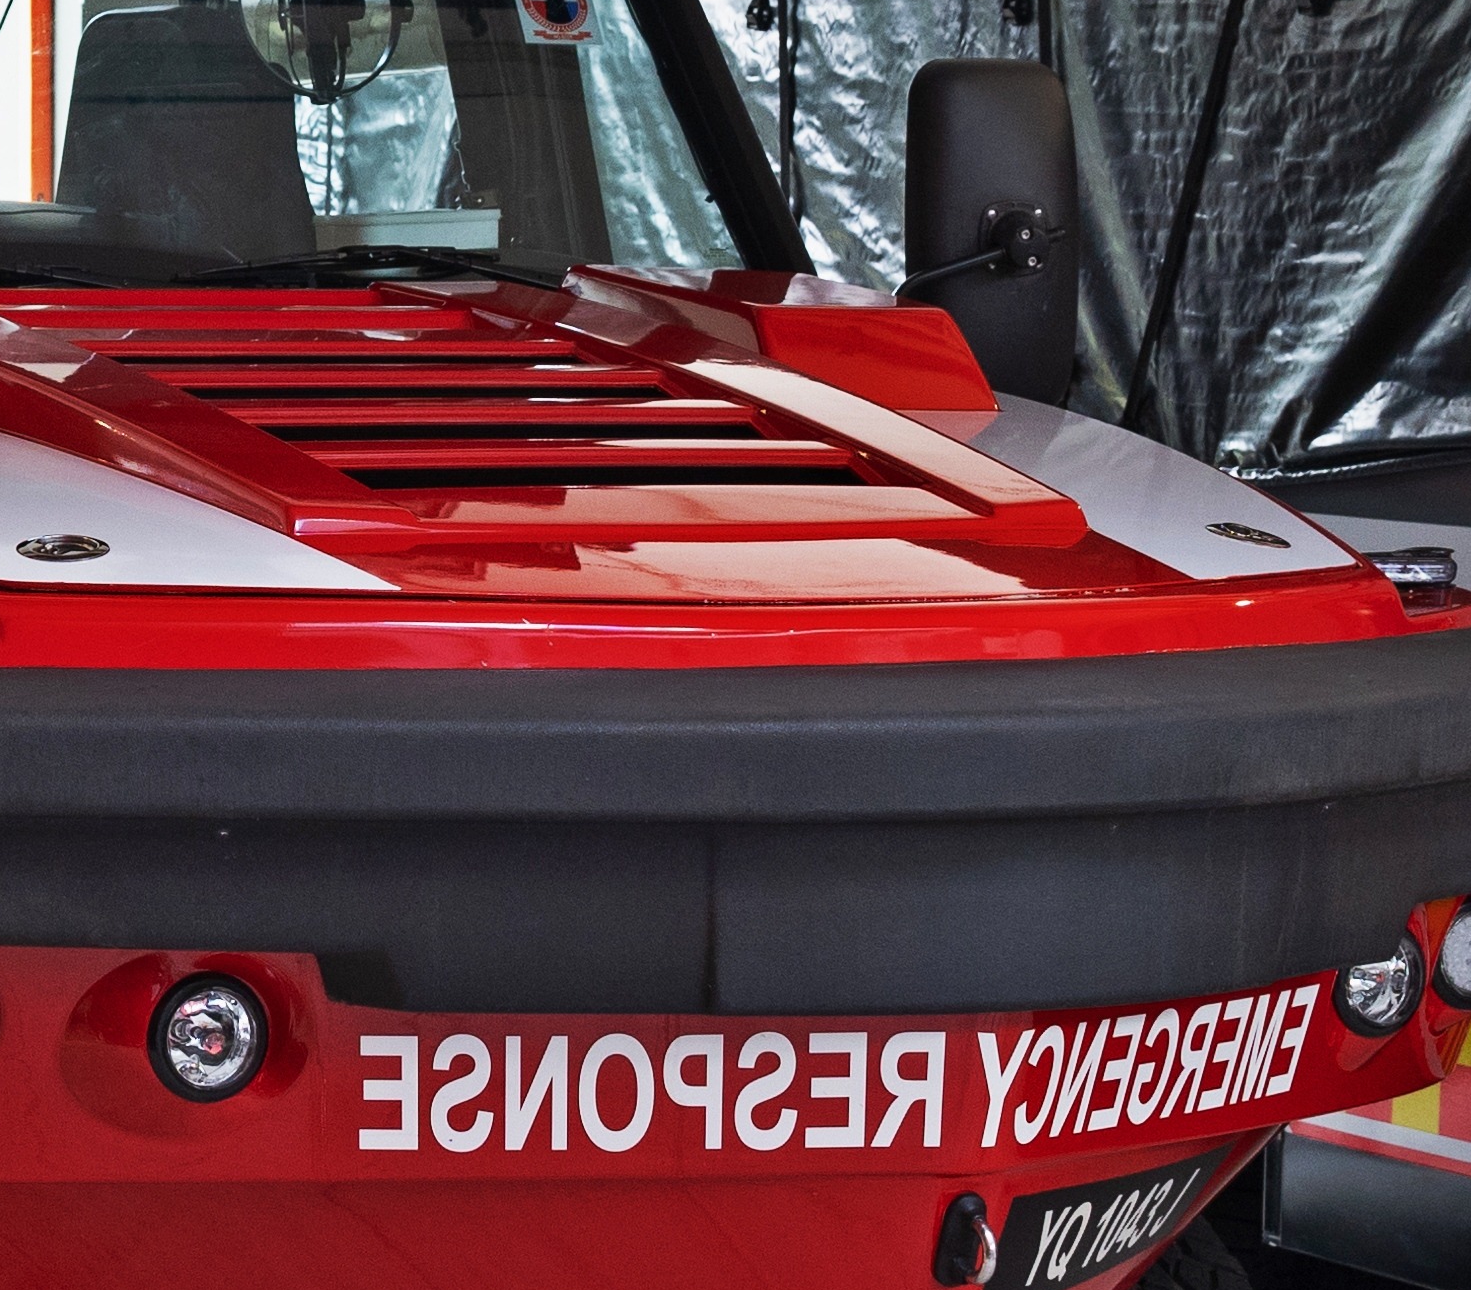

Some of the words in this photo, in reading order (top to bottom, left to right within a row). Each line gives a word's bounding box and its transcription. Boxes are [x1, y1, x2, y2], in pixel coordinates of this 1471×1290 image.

[1025, 1201, 1092, 1286] YQ
[1081, 1178, 1174, 1268] 1043
[1148, 1167, 1201, 1237] J
